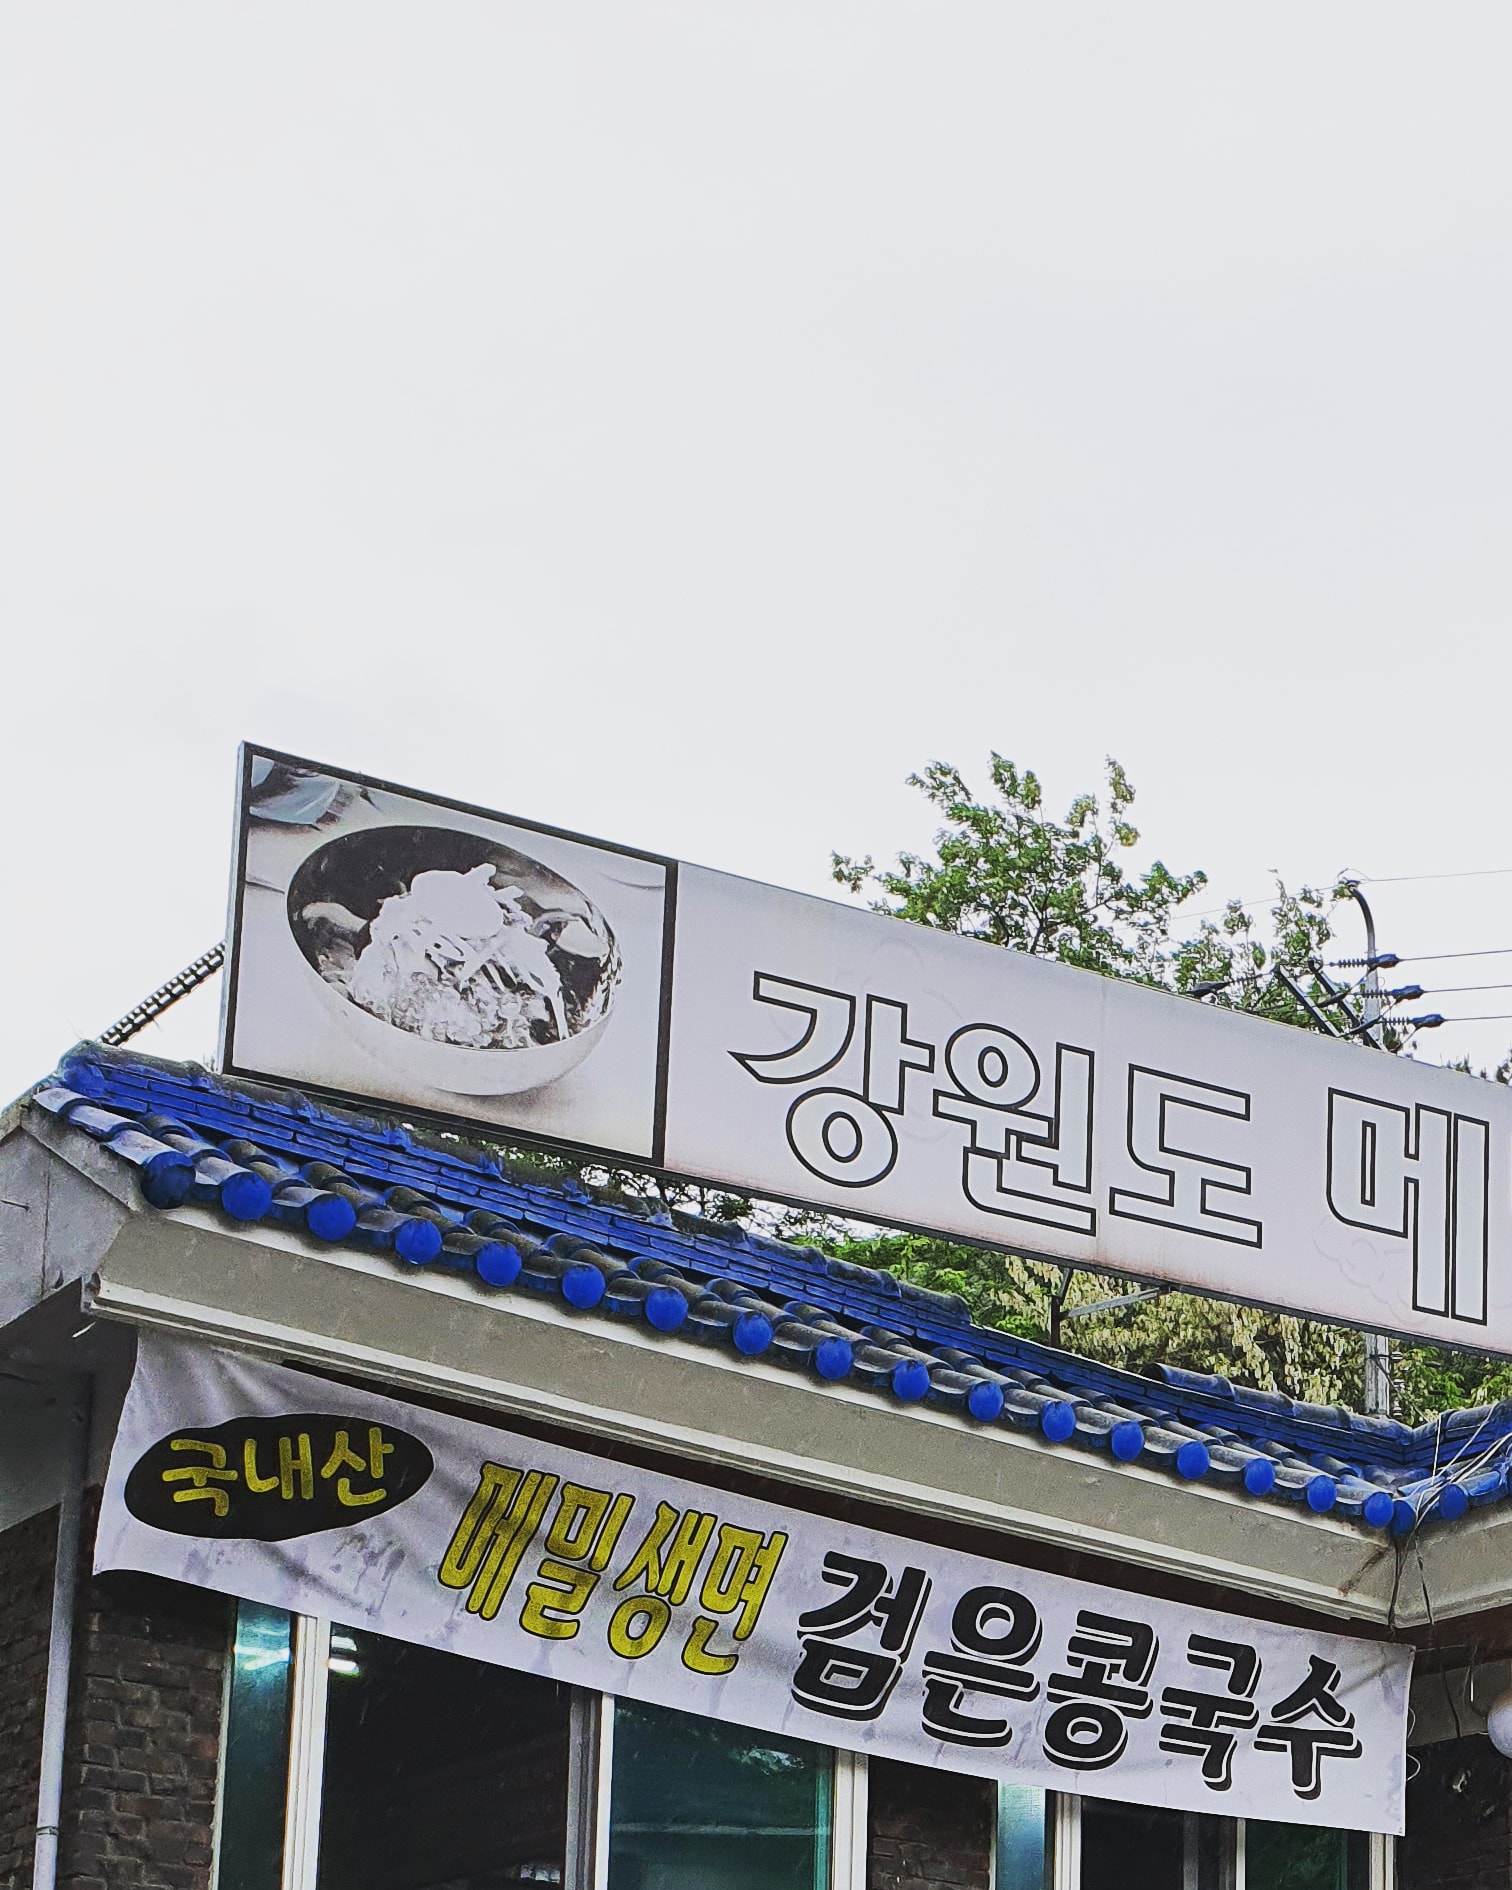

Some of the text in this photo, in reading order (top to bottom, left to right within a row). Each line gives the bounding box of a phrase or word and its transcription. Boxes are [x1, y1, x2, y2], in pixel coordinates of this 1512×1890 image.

[727, 969, 1263, 1249] 강원도
[159, 1425, 399, 1519] 국내산
[436, 1460, 1364, 1801] 메밀생면 검은콩국수
